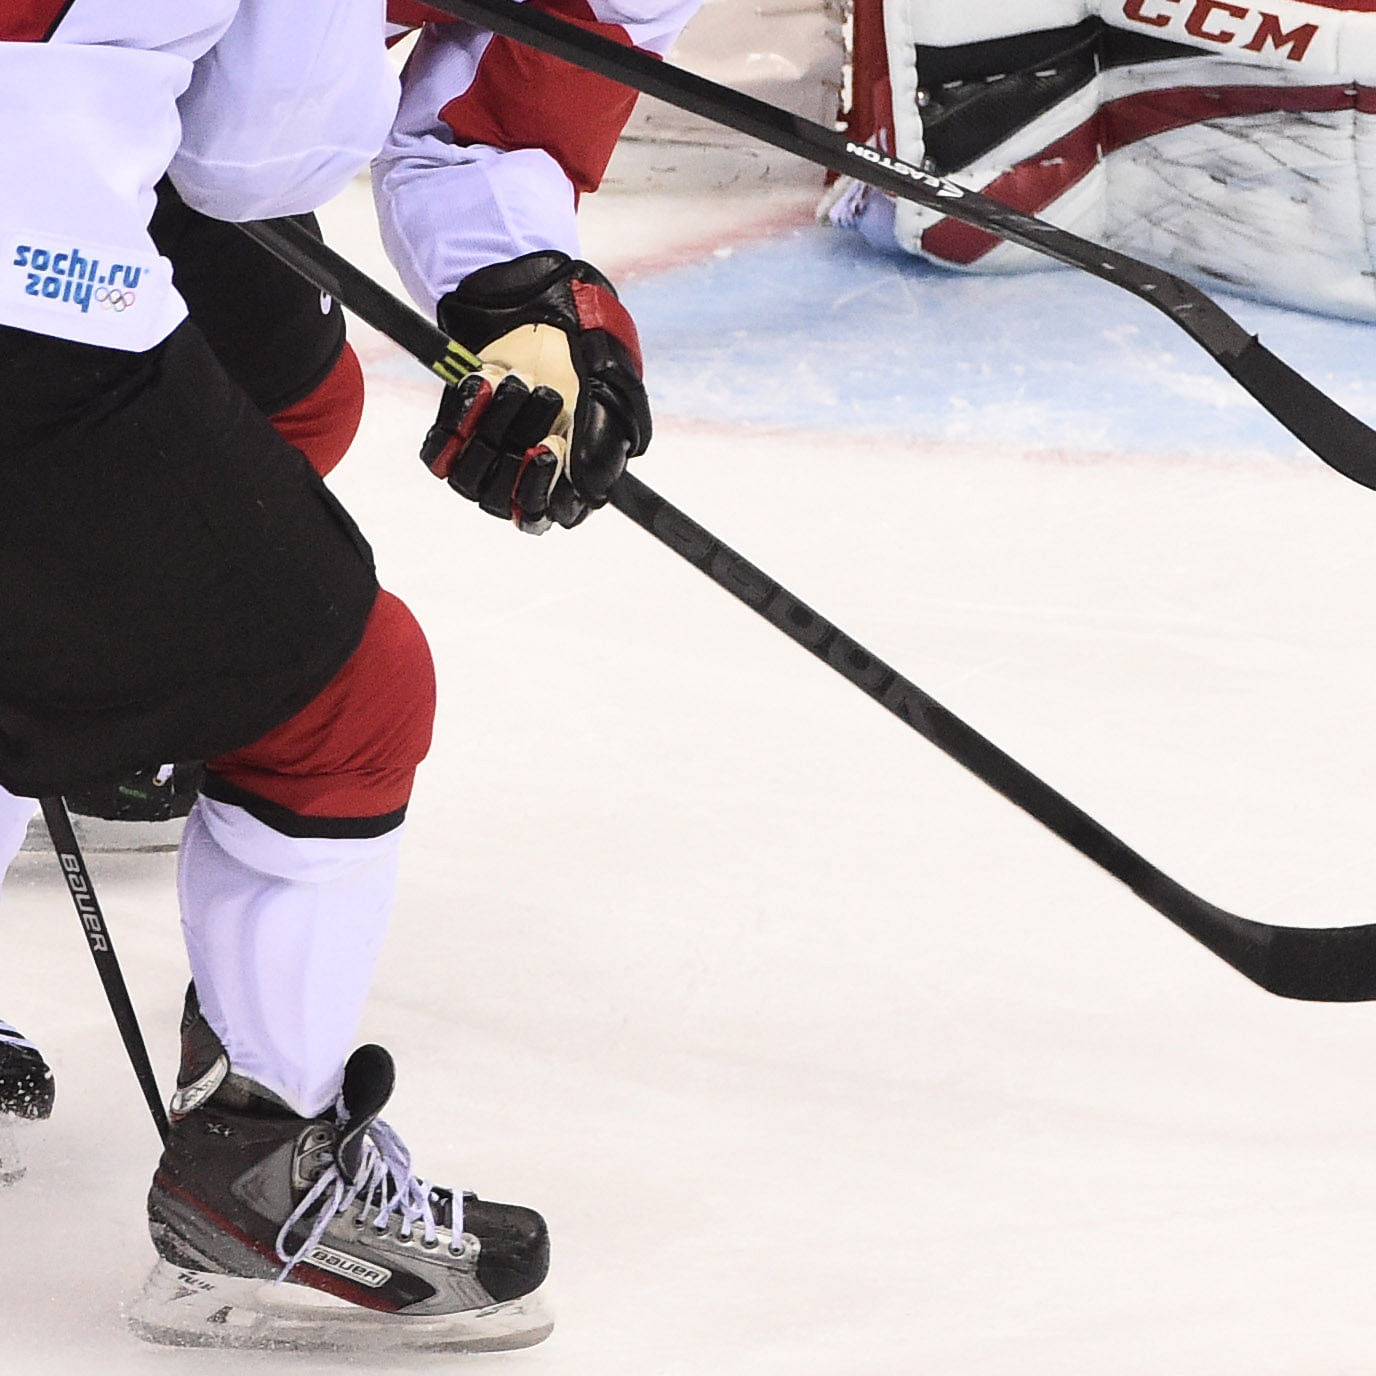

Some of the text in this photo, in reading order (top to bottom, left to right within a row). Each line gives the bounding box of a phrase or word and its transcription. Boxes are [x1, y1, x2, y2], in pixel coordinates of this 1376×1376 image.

[845, 142, 941, 188] EASTON
[12, 244, 143, 290] sochi.ru
[24, 272, 95, 314] 2014
